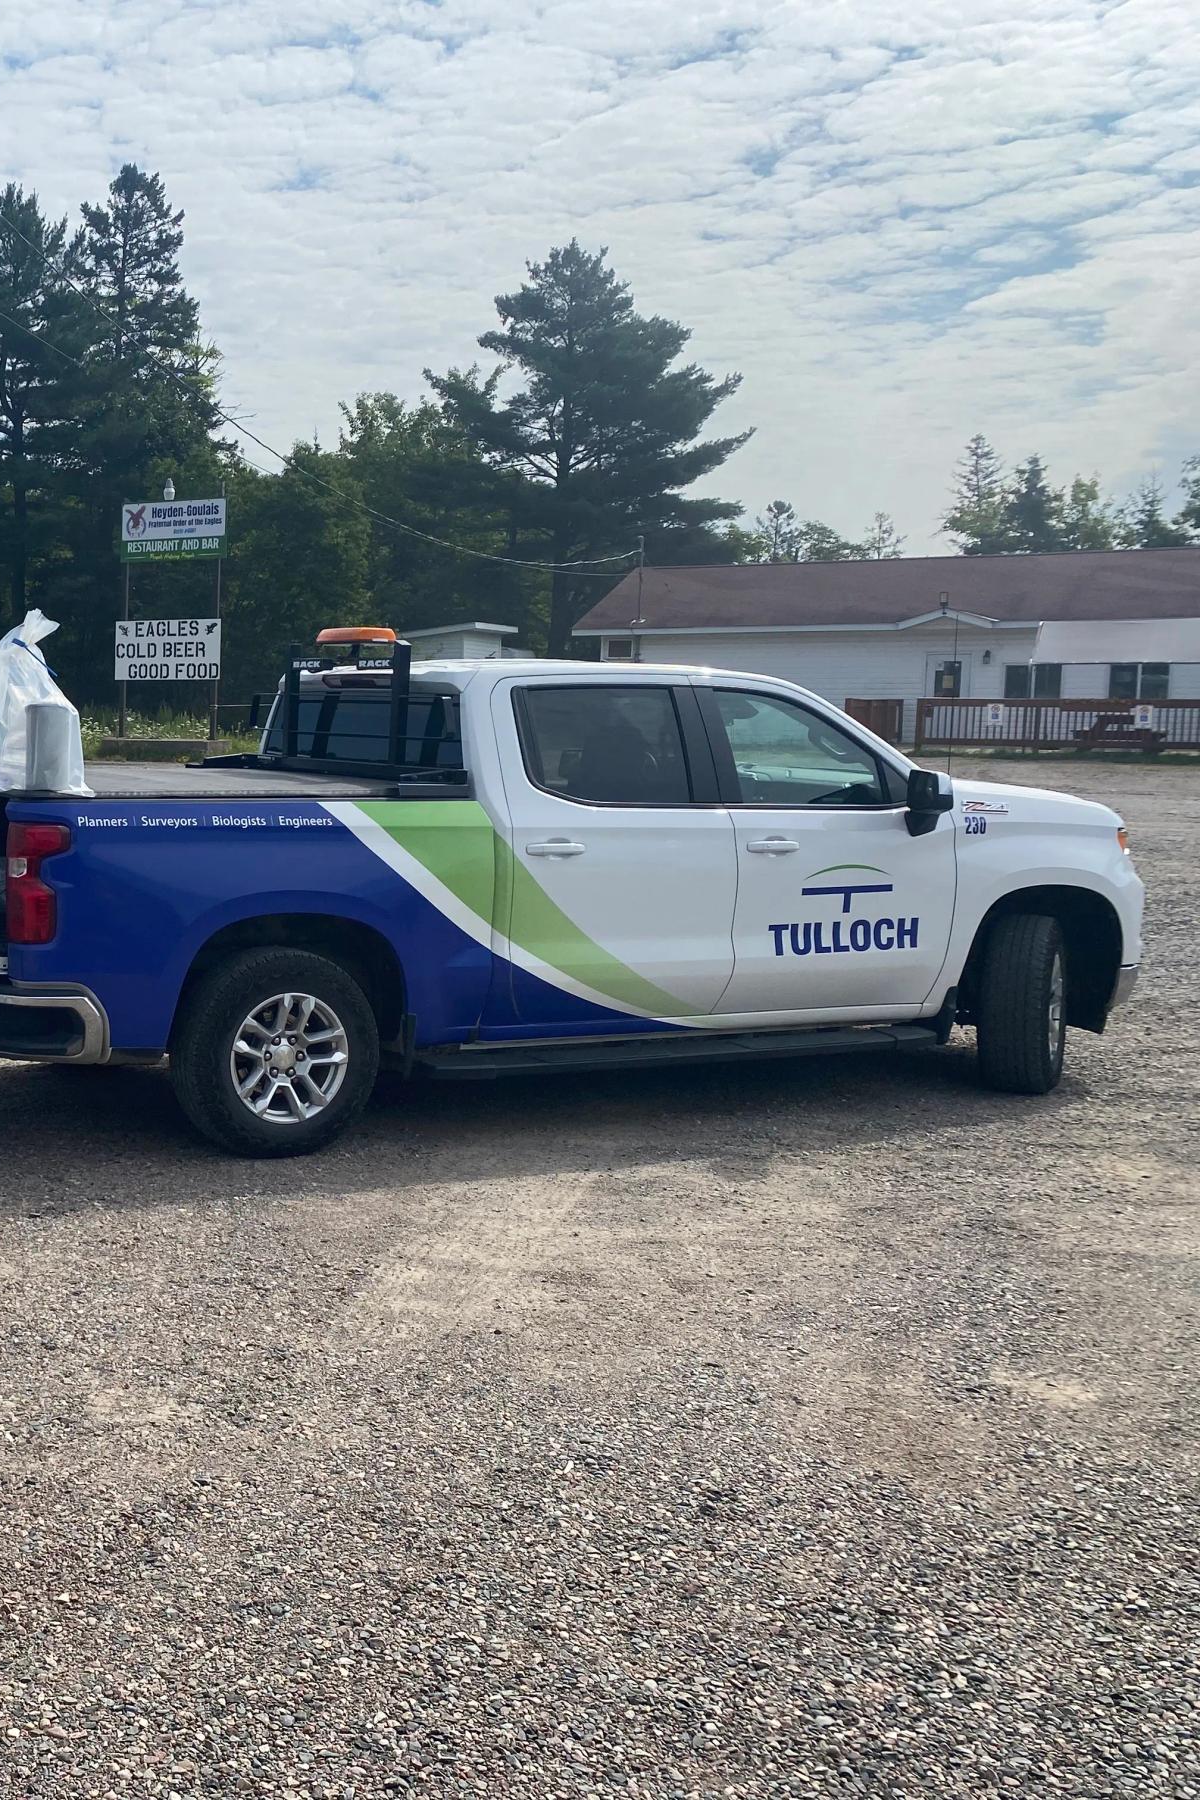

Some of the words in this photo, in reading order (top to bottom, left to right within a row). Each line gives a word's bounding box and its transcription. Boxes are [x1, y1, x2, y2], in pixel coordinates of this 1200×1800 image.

[151, 503, 219, 519] Heyden-Goulais
[173, 519, 187, 527] Order
[204, 517, 222, 525] Eagles
[127, 540, 179, 553] RESTAURANT
[182, 539, 199, 550] AND
[201, 538, 219, 549] BAR
[135, 620, 199, 637] EAGLES
[116, 643, 157, 658] COLD
[163, 642, 206, 657] BEER
[128, 663, 169, 679] GOOD
[175, 663, 219, 678] FOOD
[293, 660, 321, 668] BACK
[358, 659, 390, 667] RACK
[77, 816, 128, 827] Planners
[141, 815, 198, 829] Surveyors
[211, 815, 267, 829] Biologists
[278, 815, 333, 828] Engineers
[964, 816, 987, 835] 230
[768, 917, 920, 956] TULLOCH
